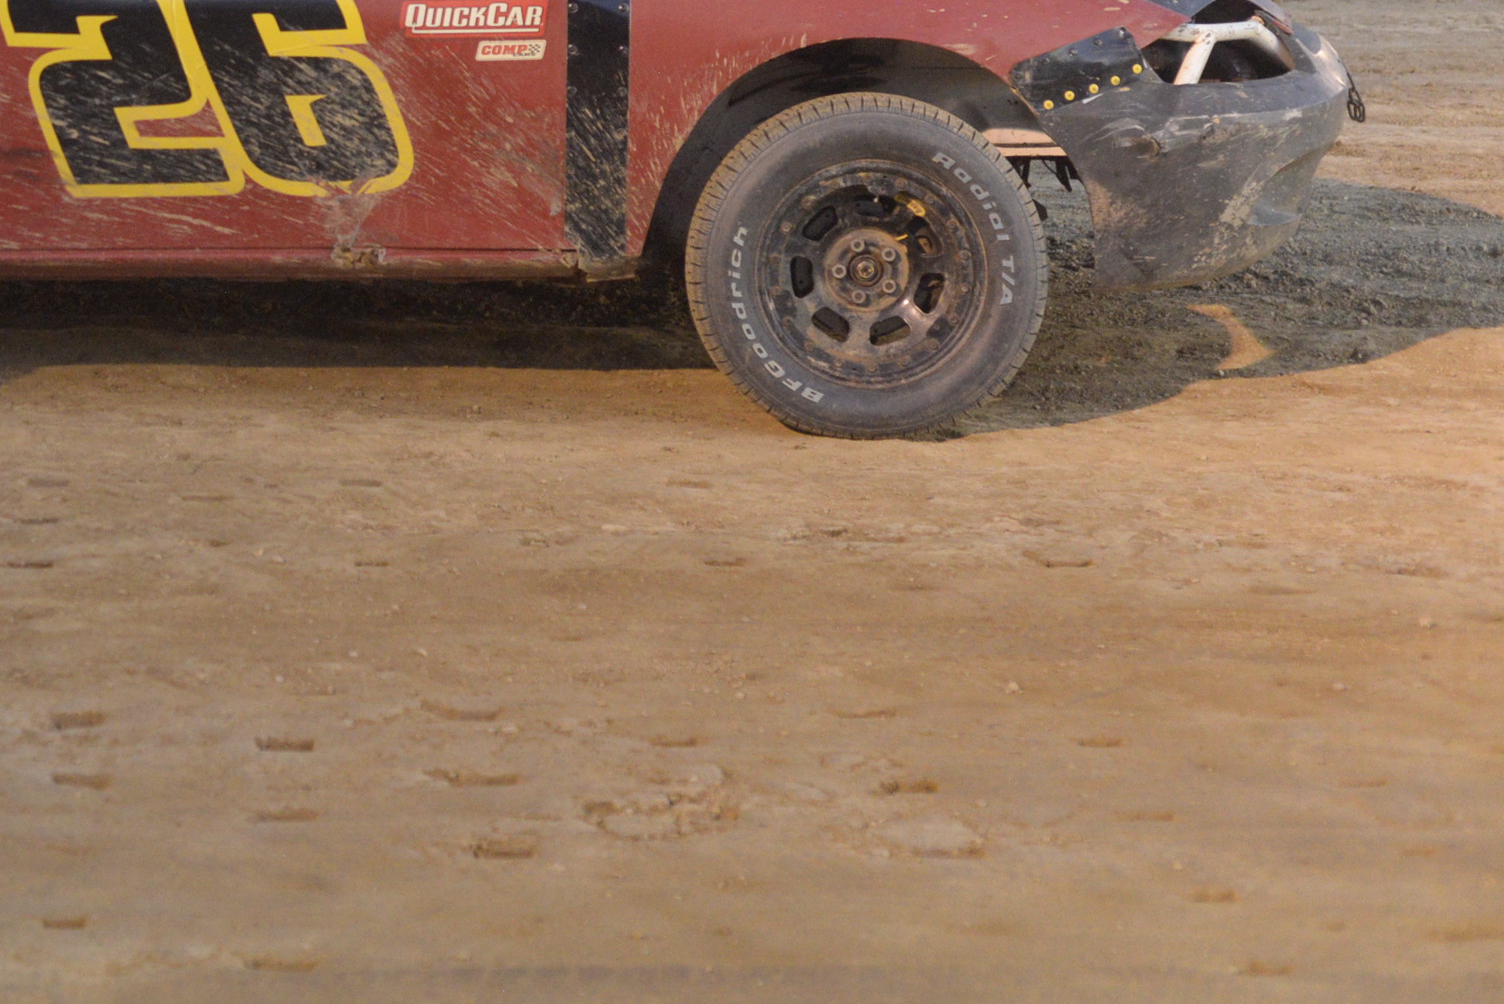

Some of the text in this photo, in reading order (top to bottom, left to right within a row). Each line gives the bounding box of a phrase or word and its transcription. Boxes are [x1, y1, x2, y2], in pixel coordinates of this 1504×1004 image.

[480, 44, 528, 56] COMP
[932, 151, 1015, 306] Radial T/A
[731, 226, 825, 404] BFGoodrich
